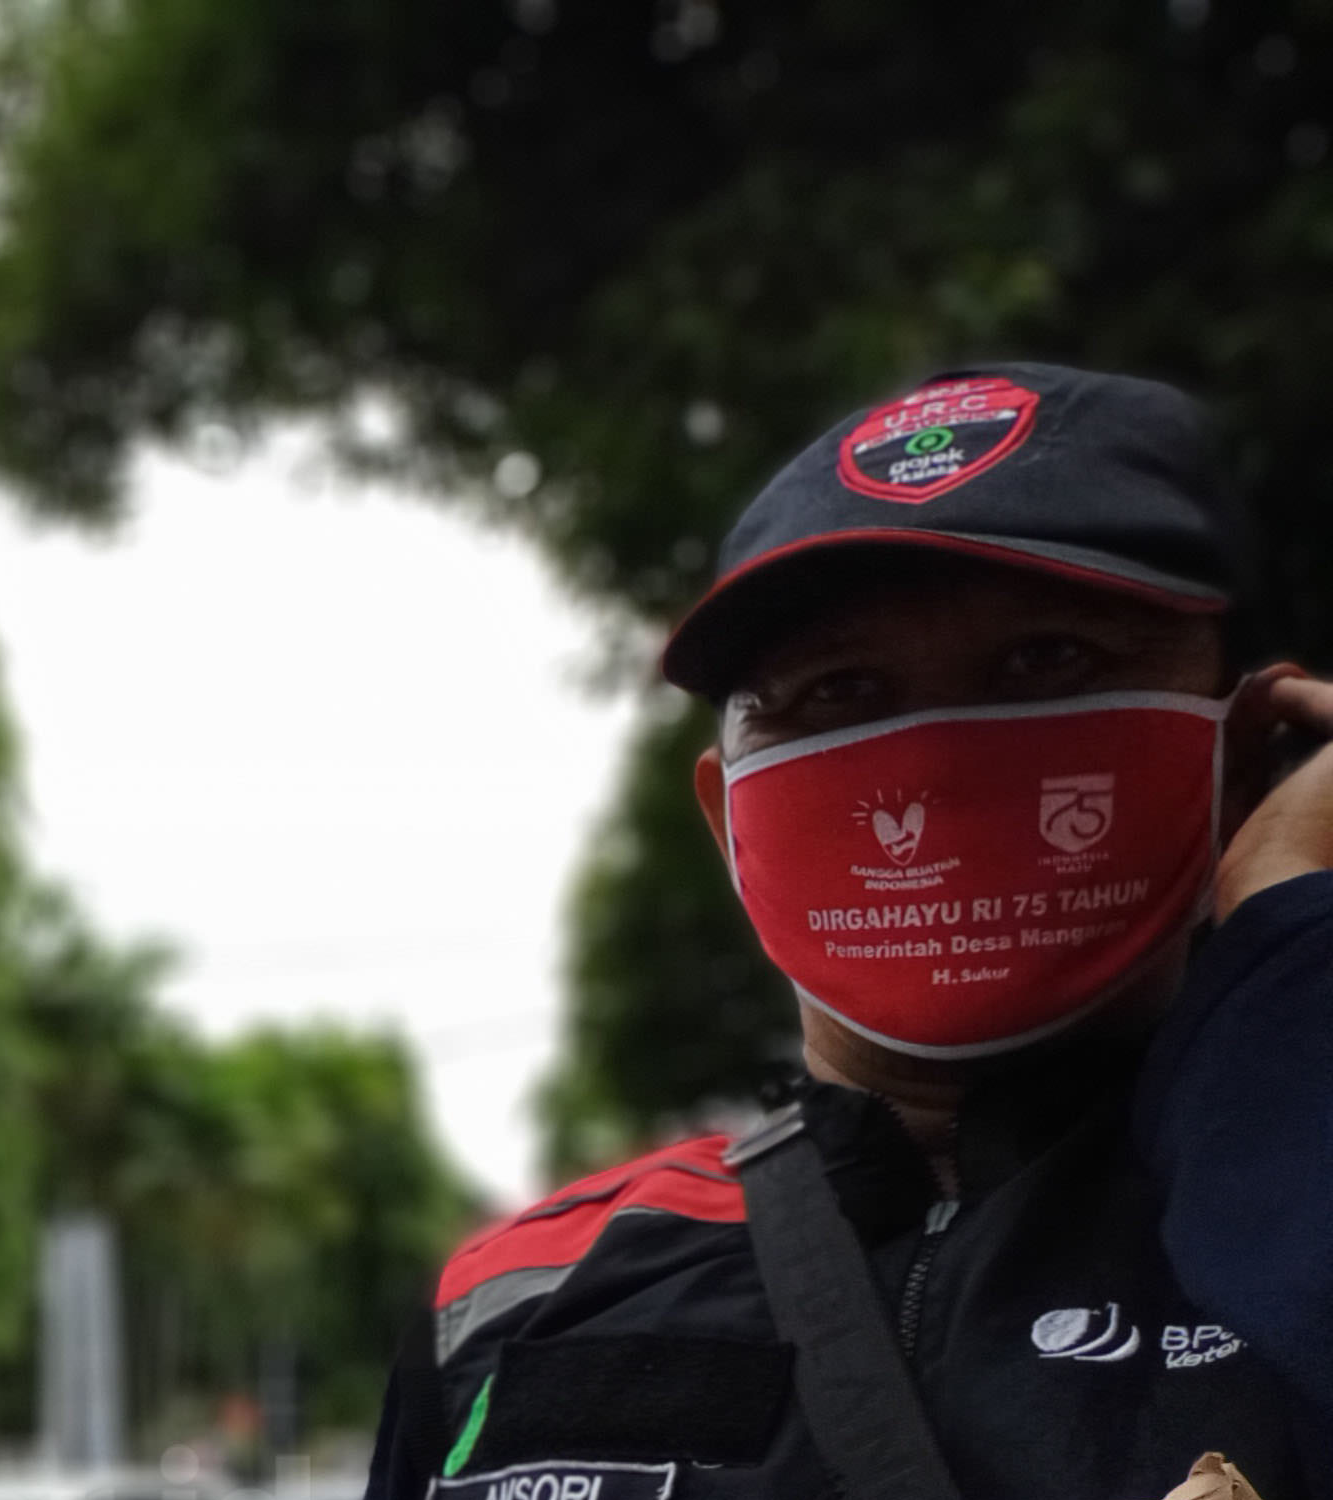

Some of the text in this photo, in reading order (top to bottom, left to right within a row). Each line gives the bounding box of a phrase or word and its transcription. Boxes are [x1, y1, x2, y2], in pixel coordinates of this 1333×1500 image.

[889, 448, 964, 475] gojek
[864, 875, 944, 891] INDONESIA
[808, 877, 1149, 932] DIRGAHAYU RI 75 TAHUN
[824, 939, 942, 960] Pemerintah
[951, 934, 1012, 957] Desa
